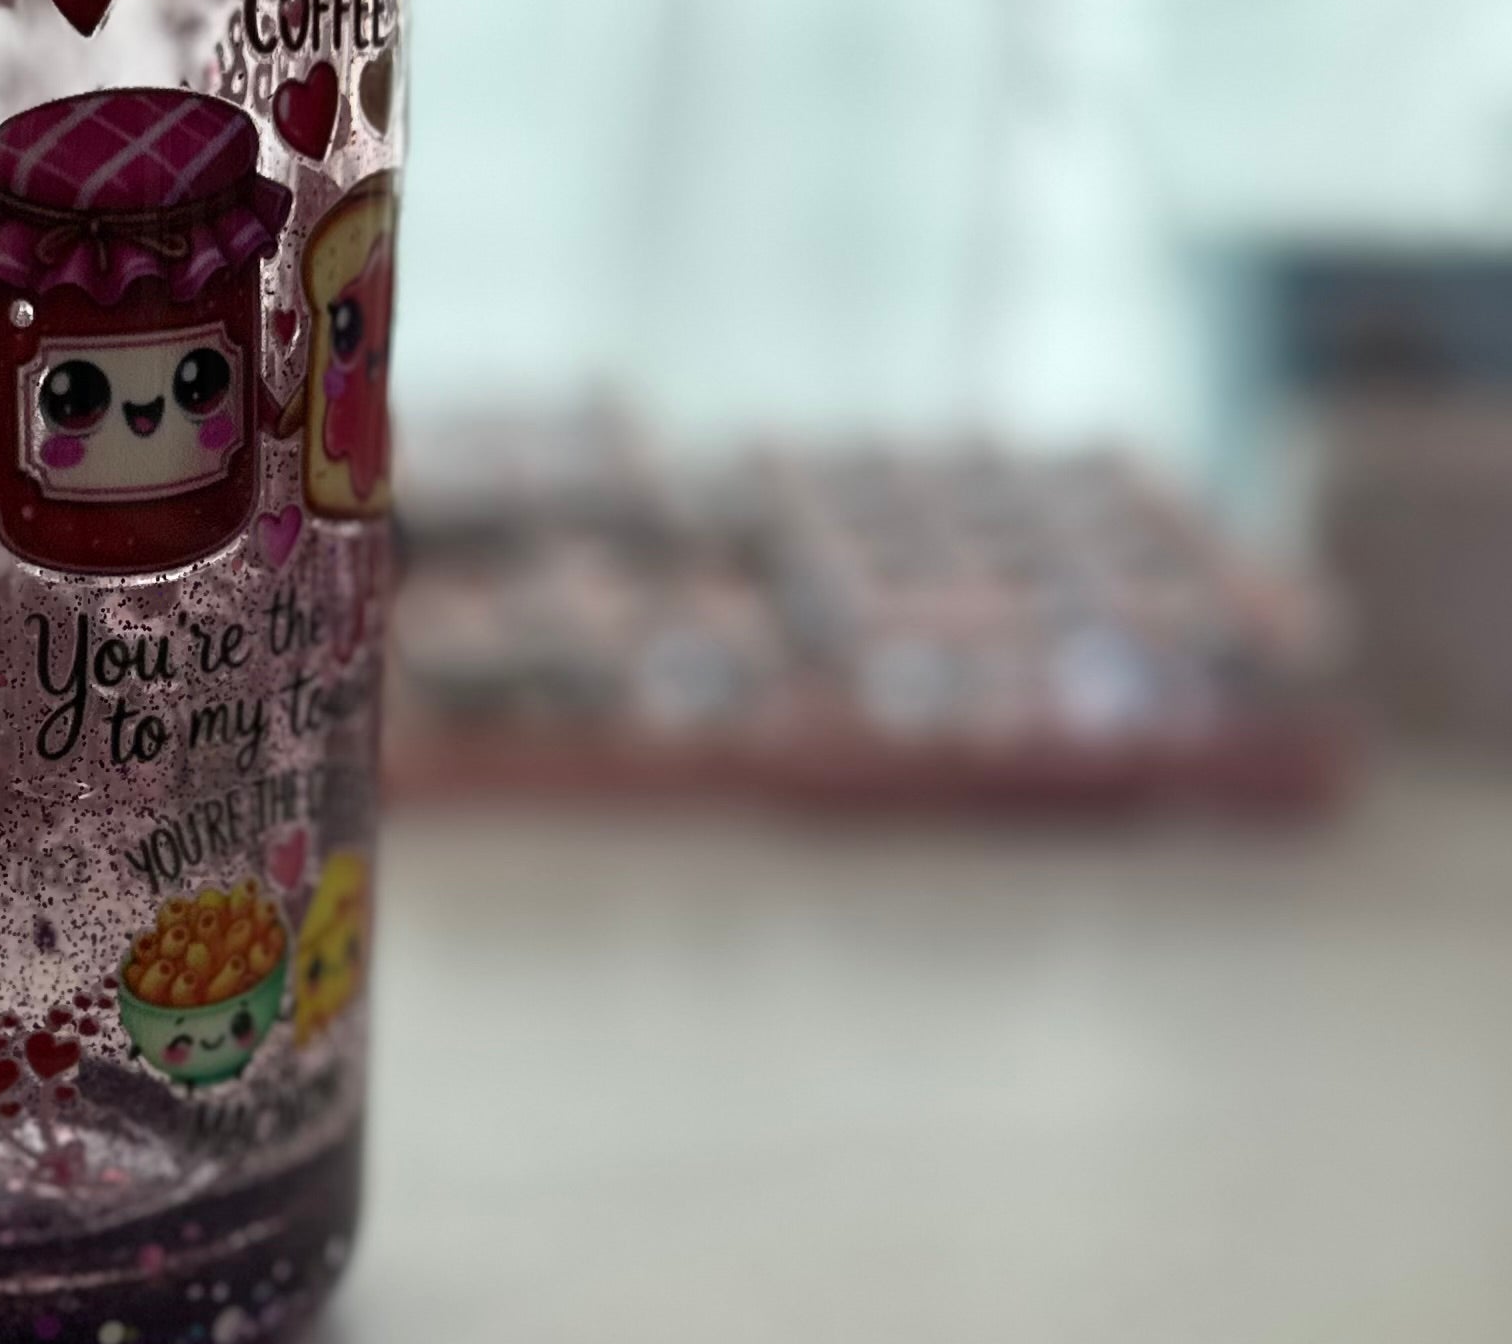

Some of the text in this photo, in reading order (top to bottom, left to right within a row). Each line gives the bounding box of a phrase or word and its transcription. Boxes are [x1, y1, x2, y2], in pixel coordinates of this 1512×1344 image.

[24, 611, 252, 761] You're
[263, 588, 324, 656] the
[104, 697, 170, 766] to
[189, 697, 272, 775] my
[124, 792, 244, 895] YOU'RE
